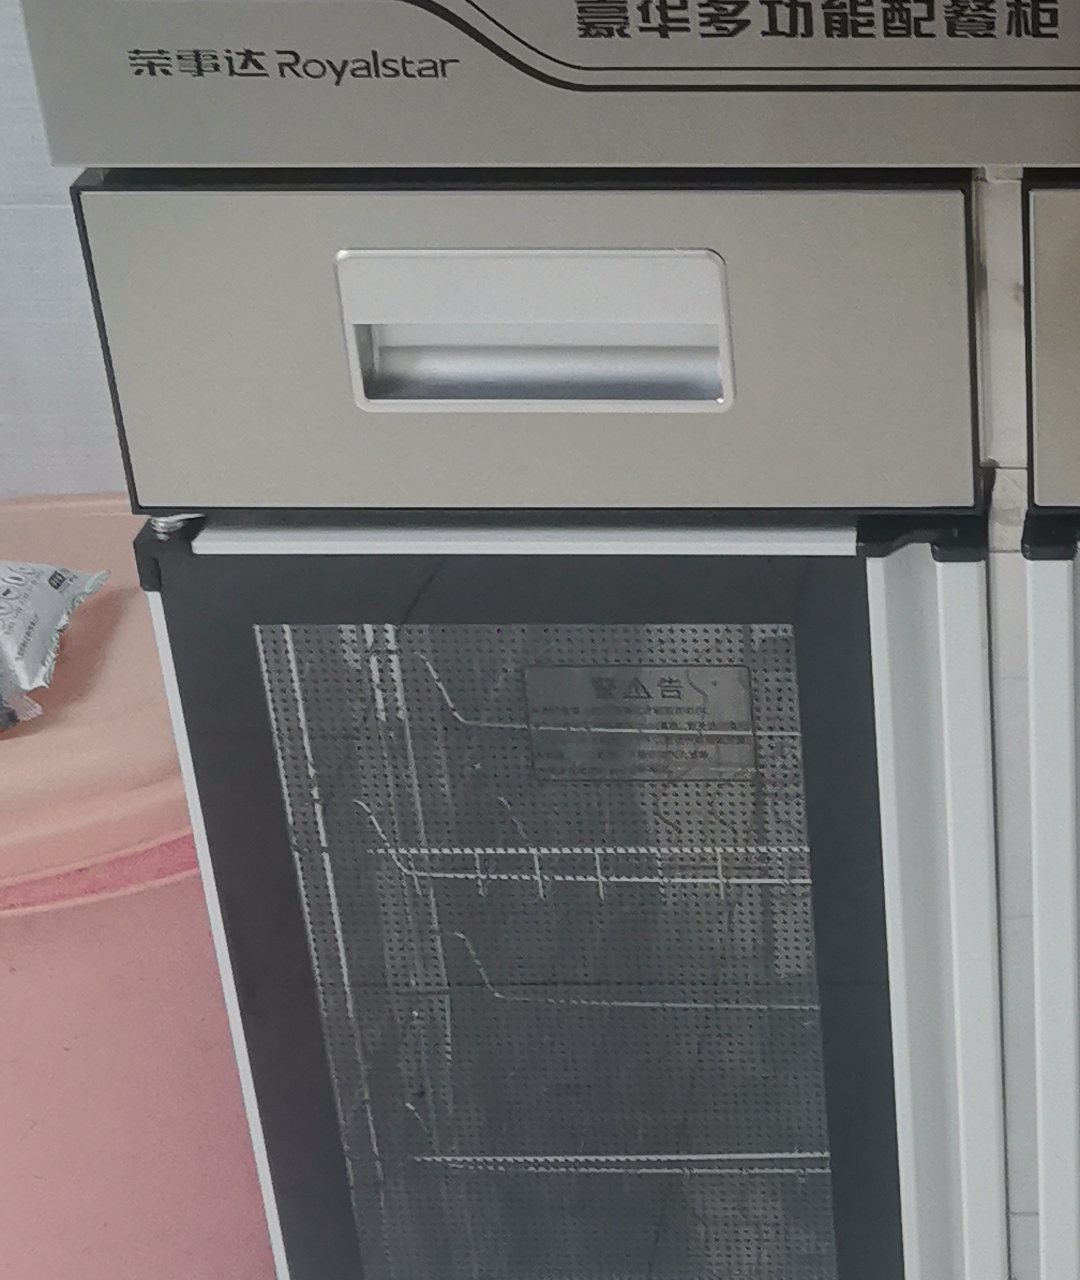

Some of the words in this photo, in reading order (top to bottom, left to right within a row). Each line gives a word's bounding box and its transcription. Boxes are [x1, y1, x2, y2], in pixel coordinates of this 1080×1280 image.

[127, 48, 271, 78] 荣事达
[274, 49, 461, 86] Royalstar
